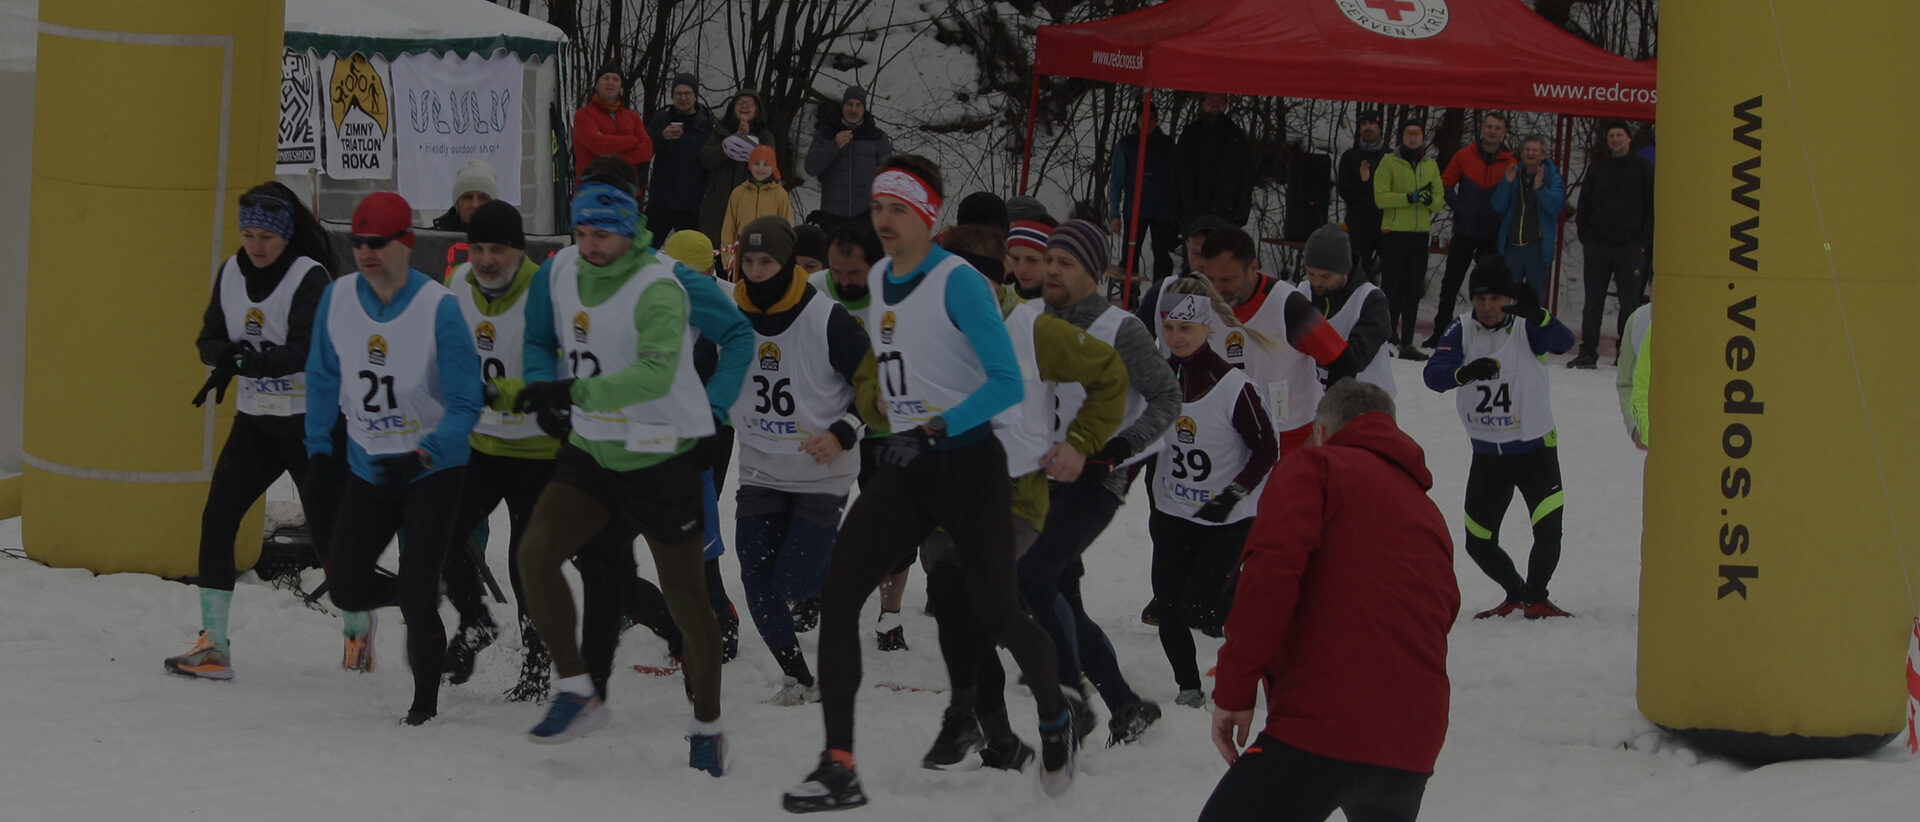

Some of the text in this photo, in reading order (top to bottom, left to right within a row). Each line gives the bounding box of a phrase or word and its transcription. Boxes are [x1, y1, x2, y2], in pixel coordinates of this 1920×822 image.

[1092, 49, 1144, 70] www.redcross.sk
[345, 122, 374, 136] ZIMNÝ
[341, 139, 381, 152] TRIATLON
[451, 143, 477, 154] outdoor
[341, 154, 380, 168] ROKA
[1717, 95, 1764, 600] www.vedos.sk
[359, 370, 397, 412] 21
[753, 375, 795, 417] 36
[1475, 383, 1512, 413] 24
[1171, 445, 1212, 482] 39
